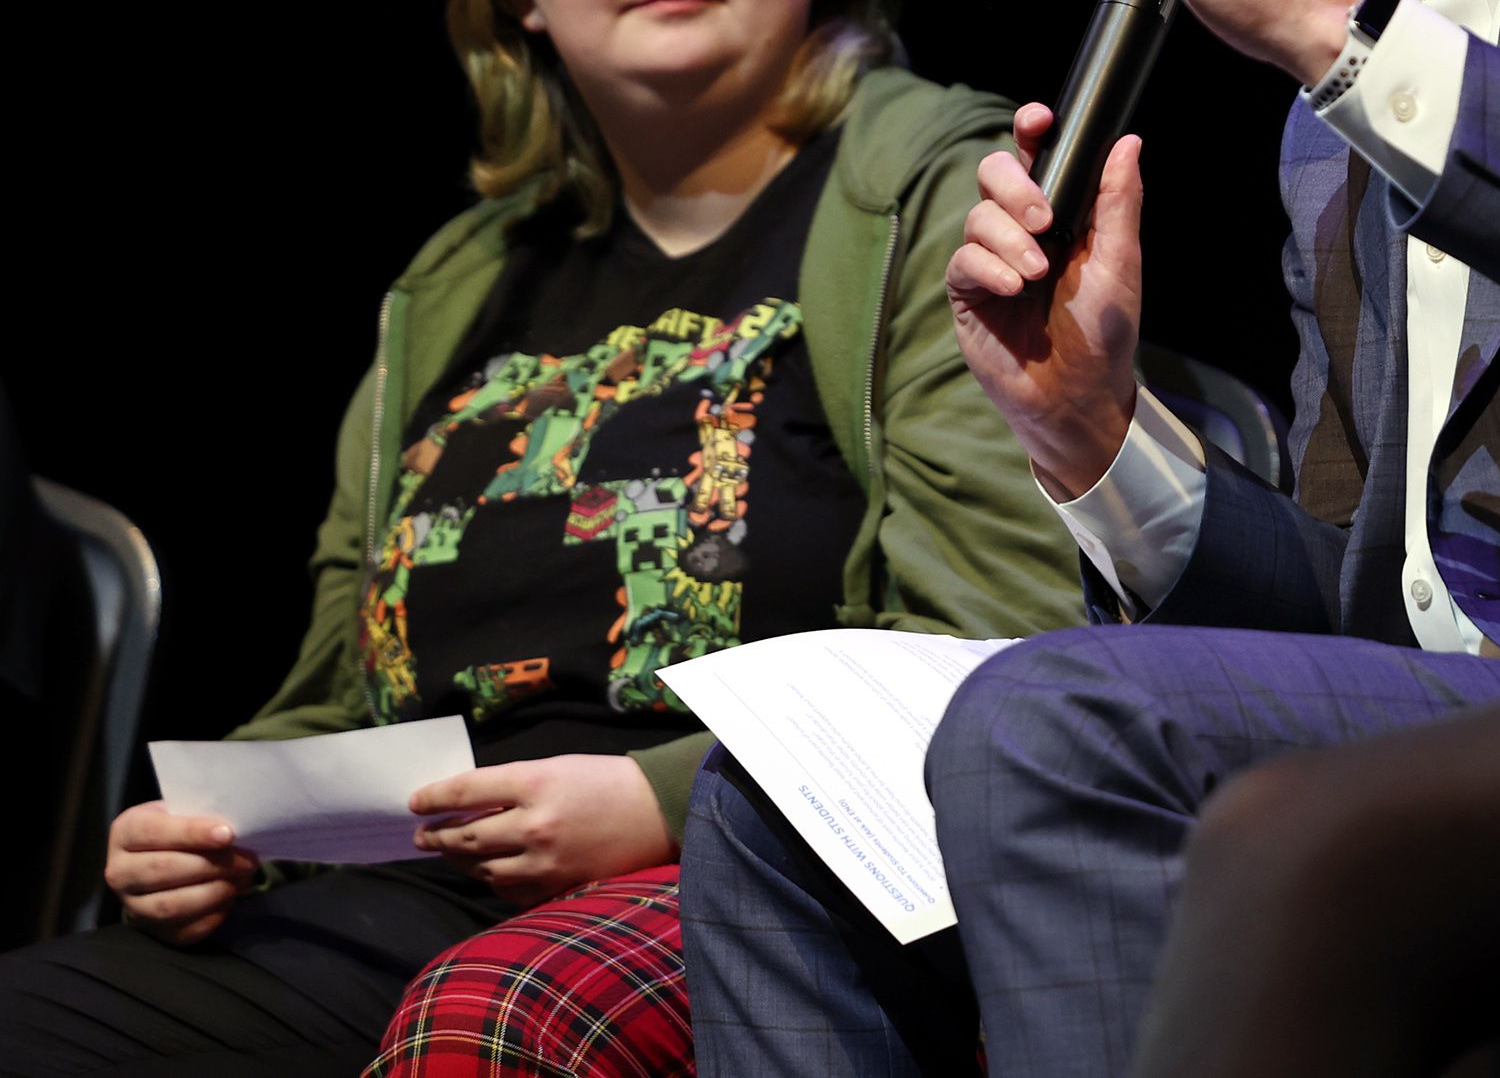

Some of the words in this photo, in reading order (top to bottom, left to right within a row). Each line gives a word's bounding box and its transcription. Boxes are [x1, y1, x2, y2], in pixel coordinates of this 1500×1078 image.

[795, 783, 846, 836] STUDENTS
[838, 833, 869, 862] WITH
[862, 859, 917, 914] QUESTIONS
